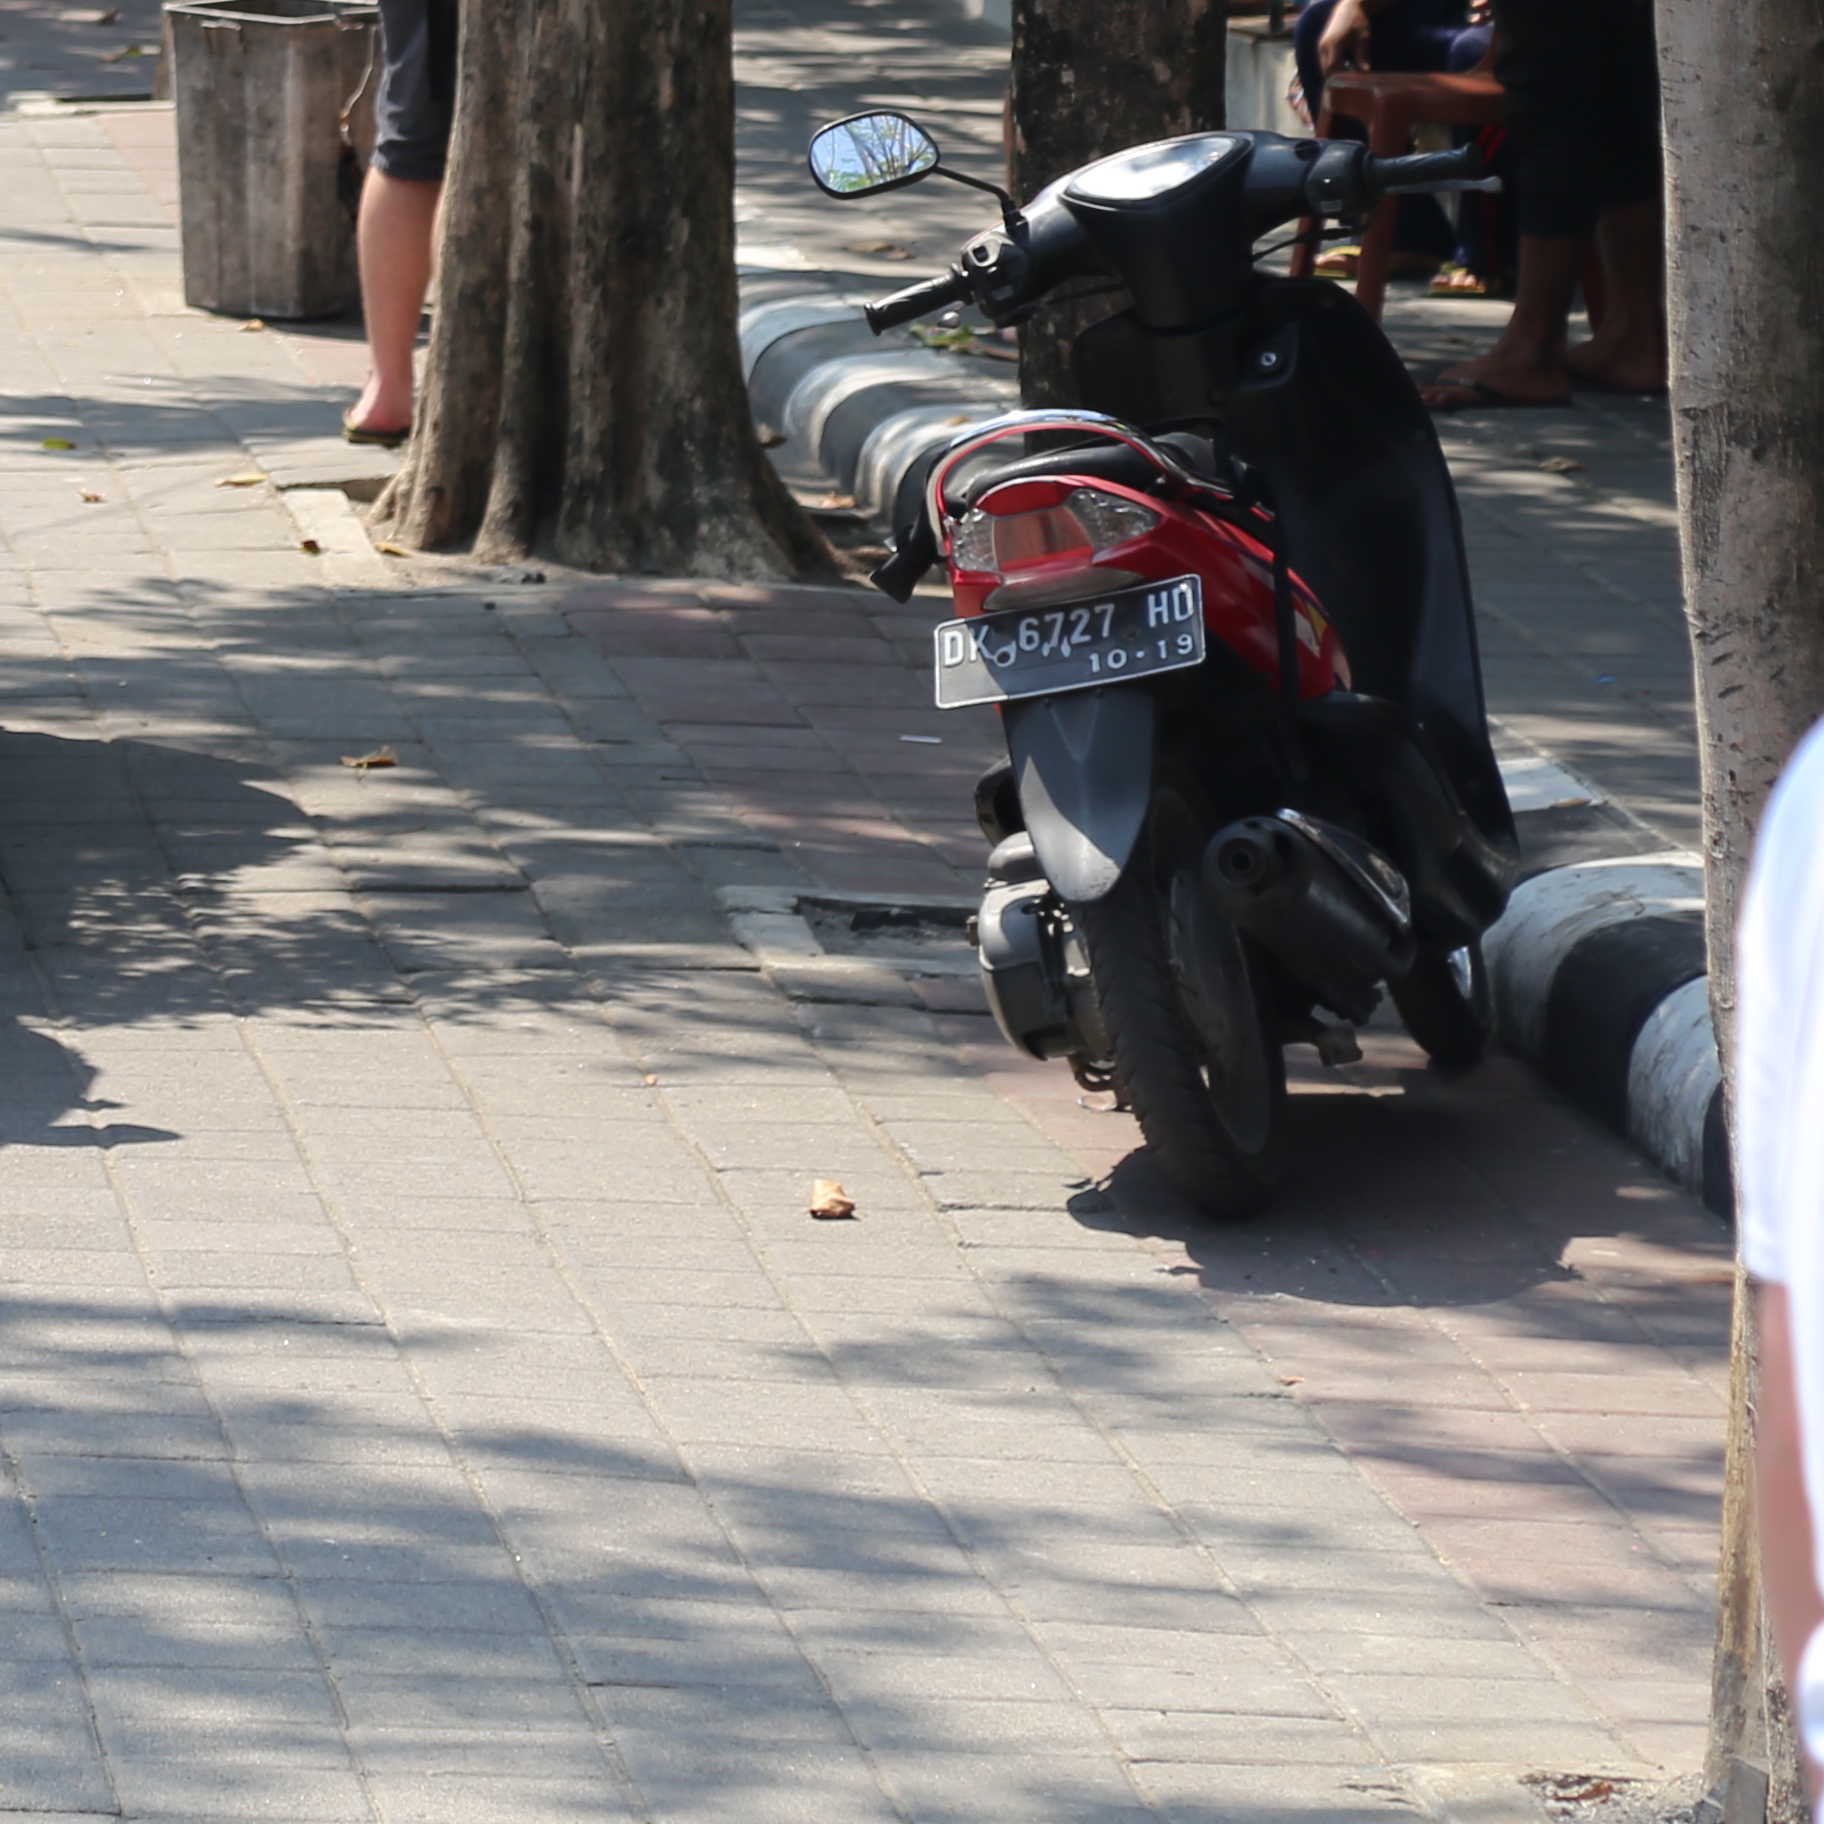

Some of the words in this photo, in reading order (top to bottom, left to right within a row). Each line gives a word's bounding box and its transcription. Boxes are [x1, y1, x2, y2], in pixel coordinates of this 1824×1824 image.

[943, 623, 995, 667] DK
[1018, 603, 1115, 652] 6727
[1147, 583, 1194, 628] HD
